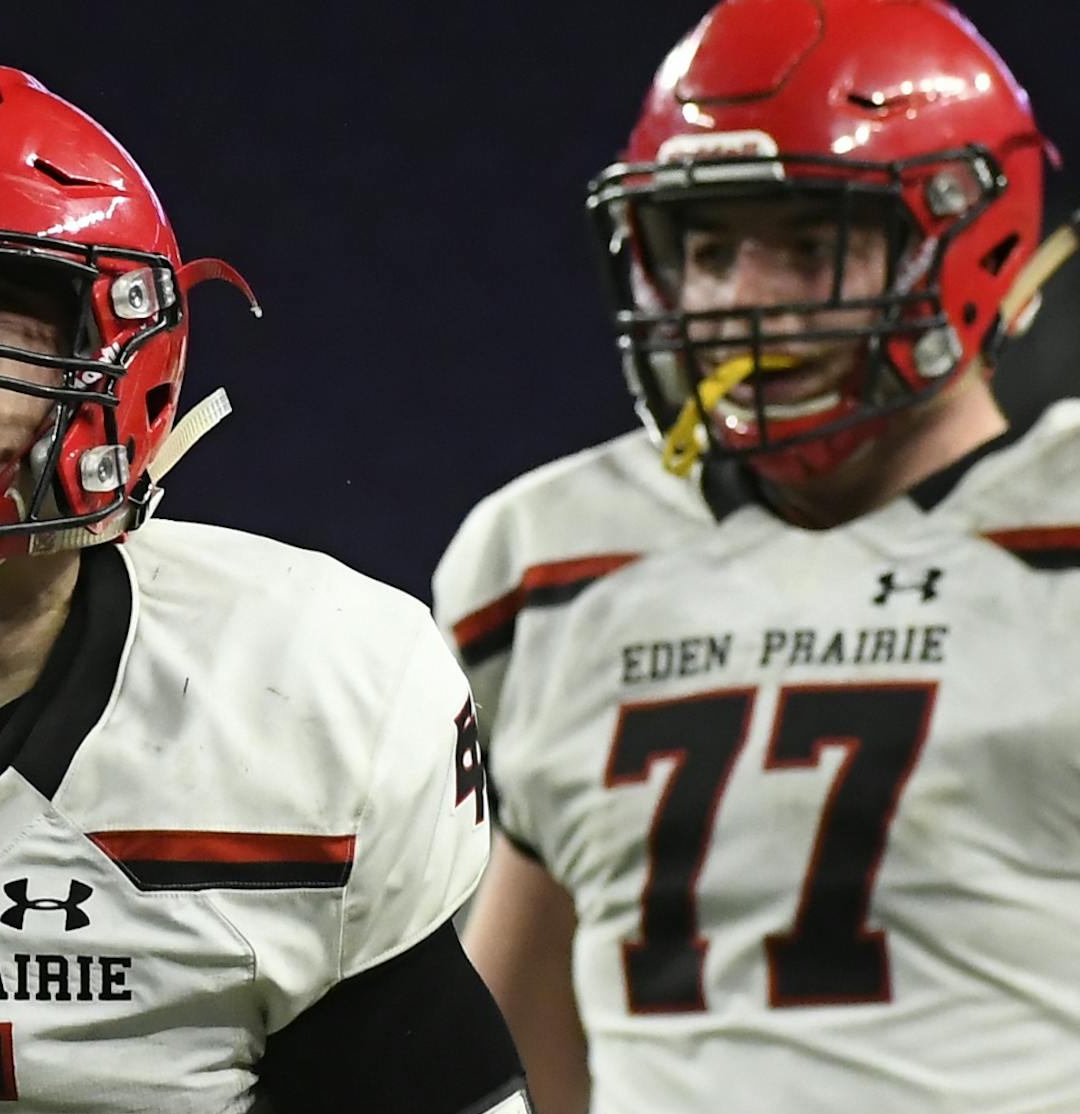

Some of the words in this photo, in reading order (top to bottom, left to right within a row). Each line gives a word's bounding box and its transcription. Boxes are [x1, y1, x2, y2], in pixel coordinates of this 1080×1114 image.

[622, 634, 733, 684] EDEN
[759, 625, 950, 667] PRAIRIE
[603, 680, 941, 1015] 77
